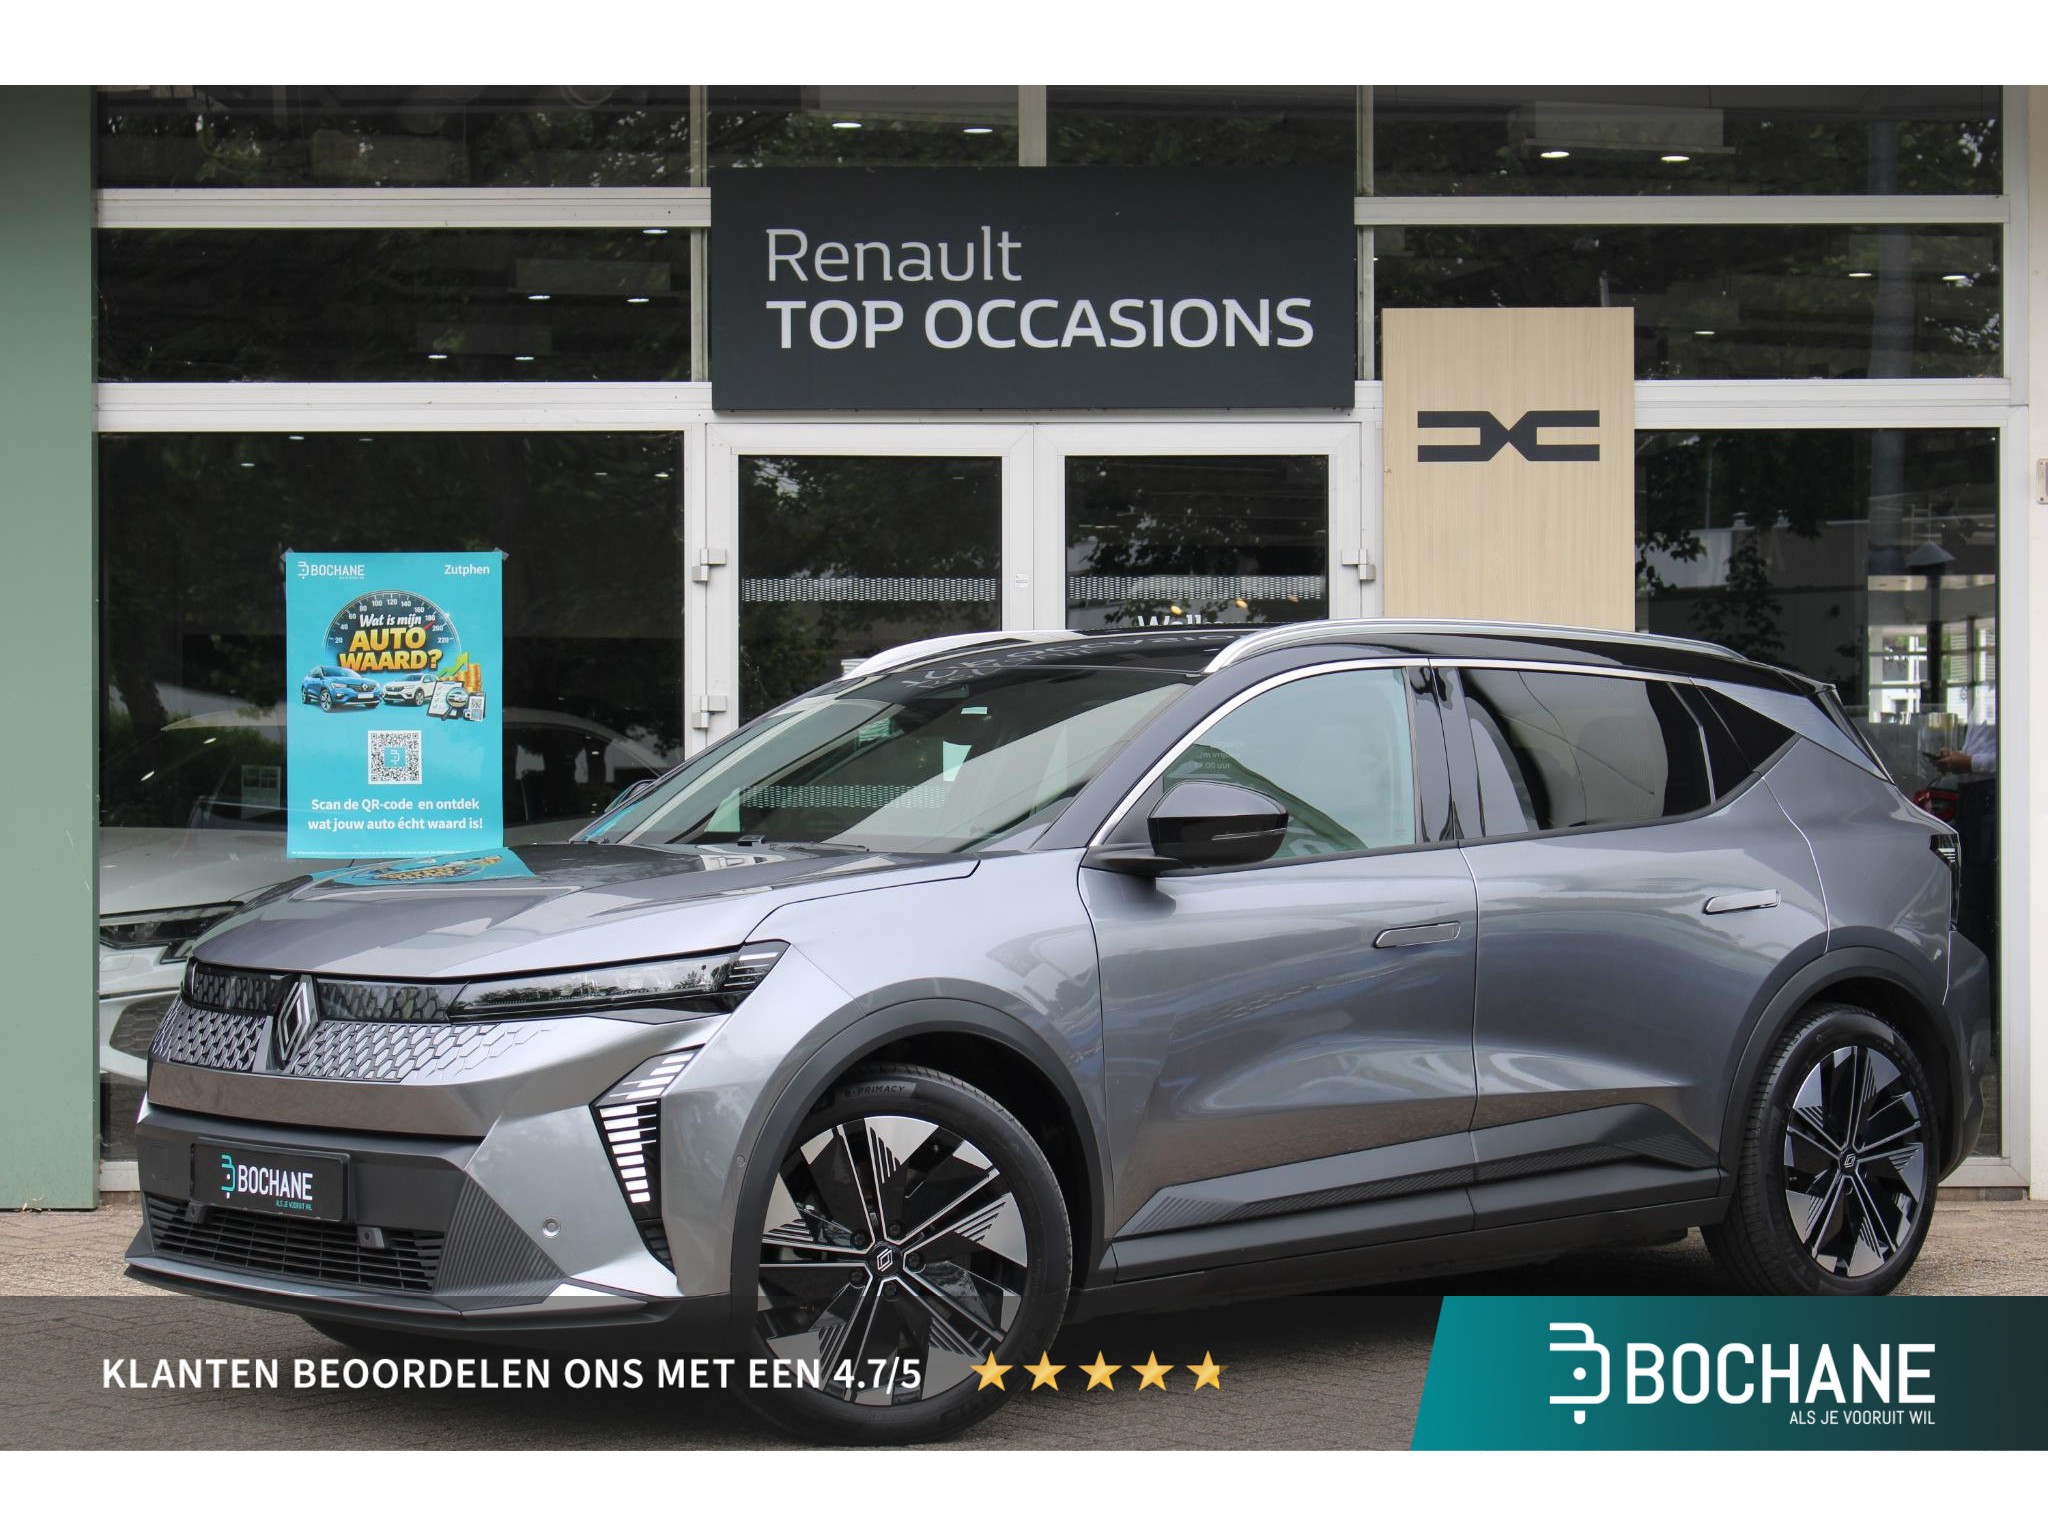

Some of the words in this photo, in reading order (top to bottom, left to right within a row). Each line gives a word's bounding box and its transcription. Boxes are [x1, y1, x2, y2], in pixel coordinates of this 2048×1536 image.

[766, 225, 1022, 282] Renault
[766, 299, 904, 350] TOP
[924, 297, 1314, 349] OCCASIONS
[310, 564, 365, 577] BOCHANE
[444, 564, 490, 578] Zutphen
[414, 606, 425, 614] 160
[340, 623, 349, 631] 40
[359, 613, 384, 628] Wat
[387, 614, 396, 626] is
[397, 613, 422, 628] mijn
[349, 627, 427, 653] AUTO
[338, 648, 443, 672] WAARD?
[311, 798, 341, 811] Scan
[343, 798, 360, 811] de
[361, 798, 414, 813] QR-code
[417, 800, 434, 811] en
[435, 798, 480, 811] ontdek
[307, 819, 332, 831] wat
[332, 818, 365, 833] jouw
[366, 819, 396, 831] auto
[397, 816, 425, 831] écht
[427, 817, 467, 831] waard
[468, 817, 483, 831] is!
[237, 1164, 313, 1201] BOCHANE
